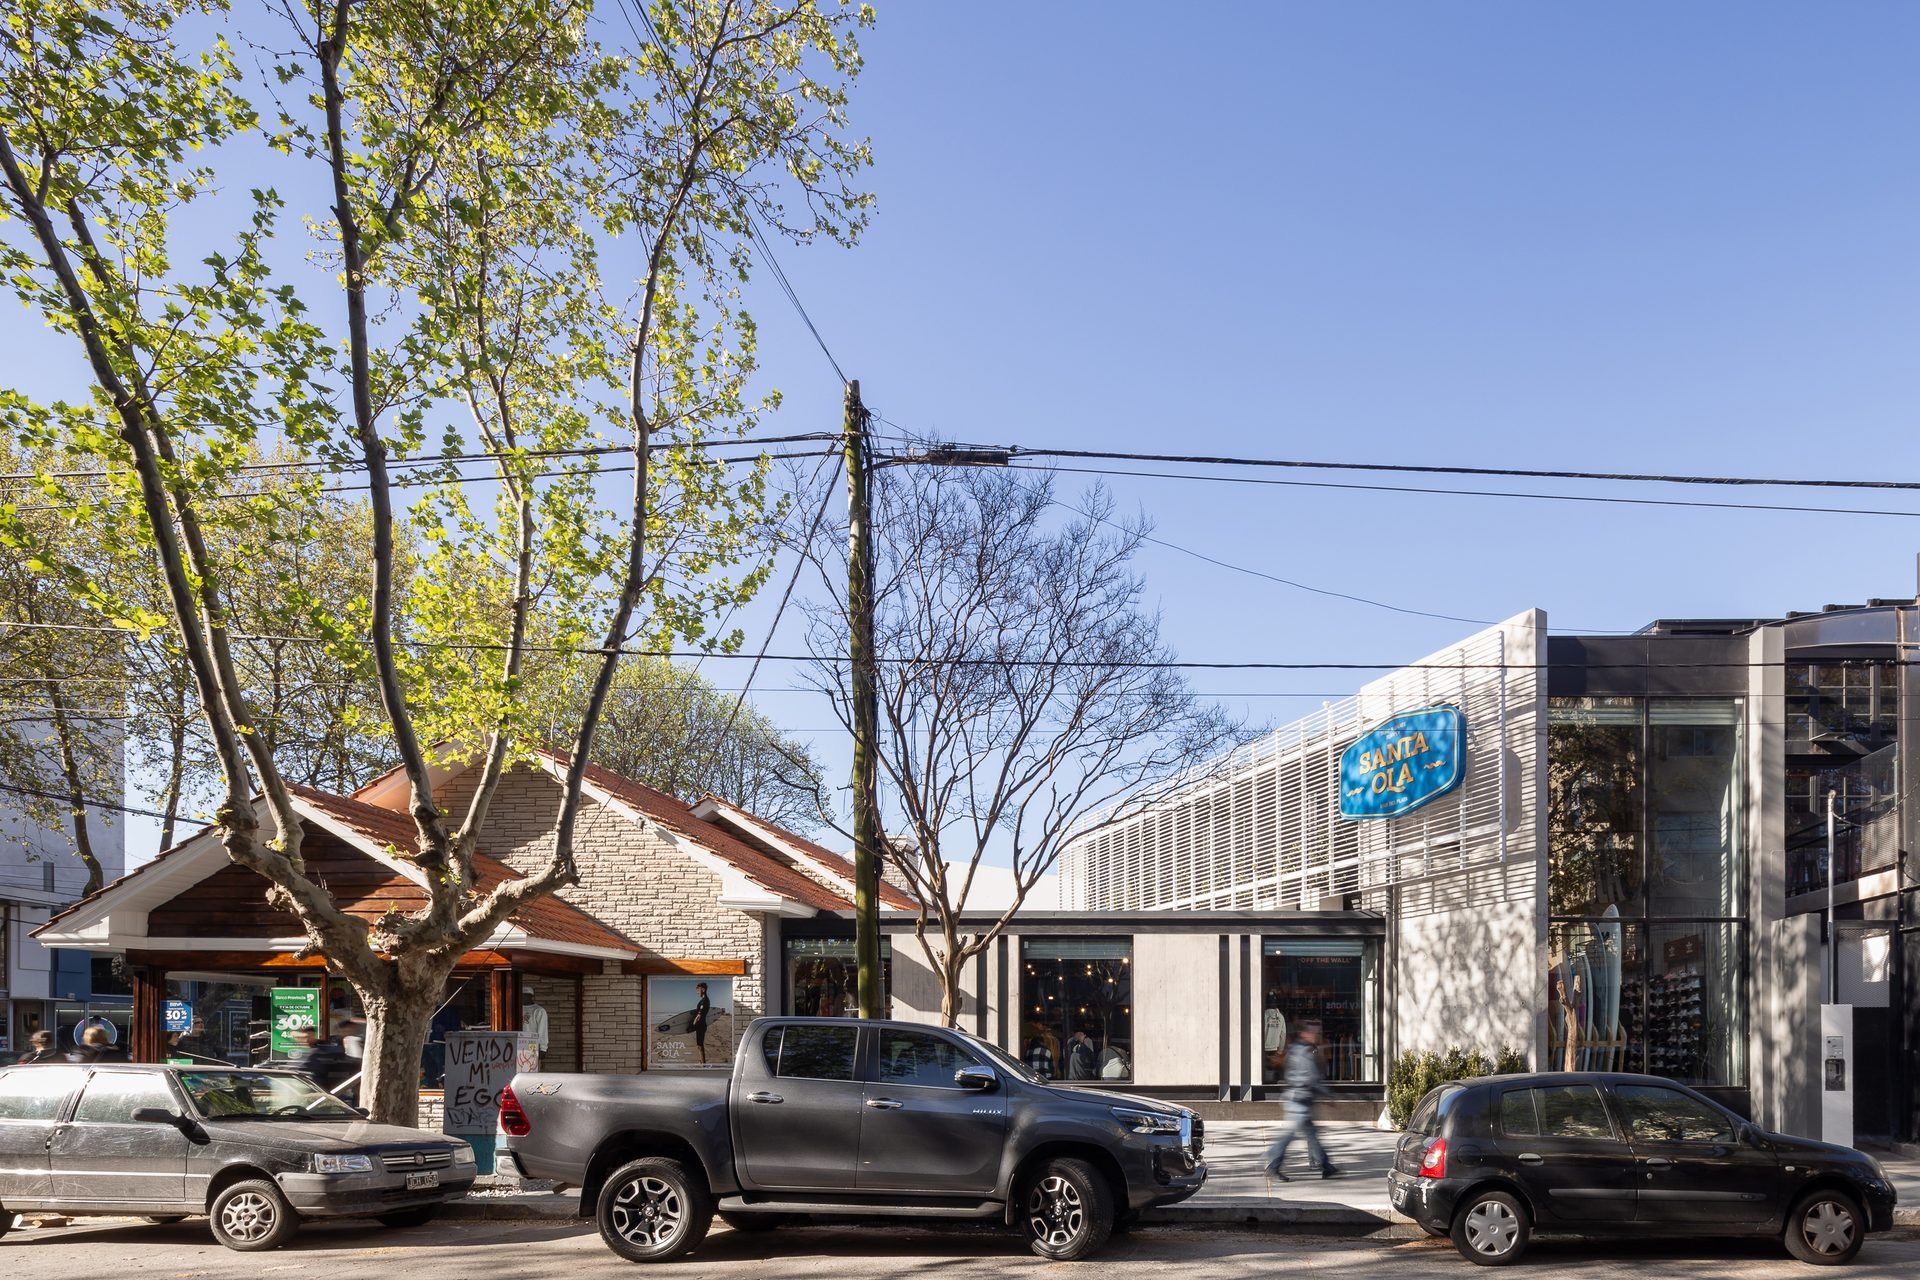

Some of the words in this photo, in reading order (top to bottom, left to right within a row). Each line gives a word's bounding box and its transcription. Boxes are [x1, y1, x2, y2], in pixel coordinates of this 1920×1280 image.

[1359, 731, 1429, 775] SANTA
[1371, 763, 1414, 794] OLA
[450, 1038, 514, 1065] VENDO
[656, 1041, 686, 1049] SANTA
[662, 1049, 680, 1058] OLA
